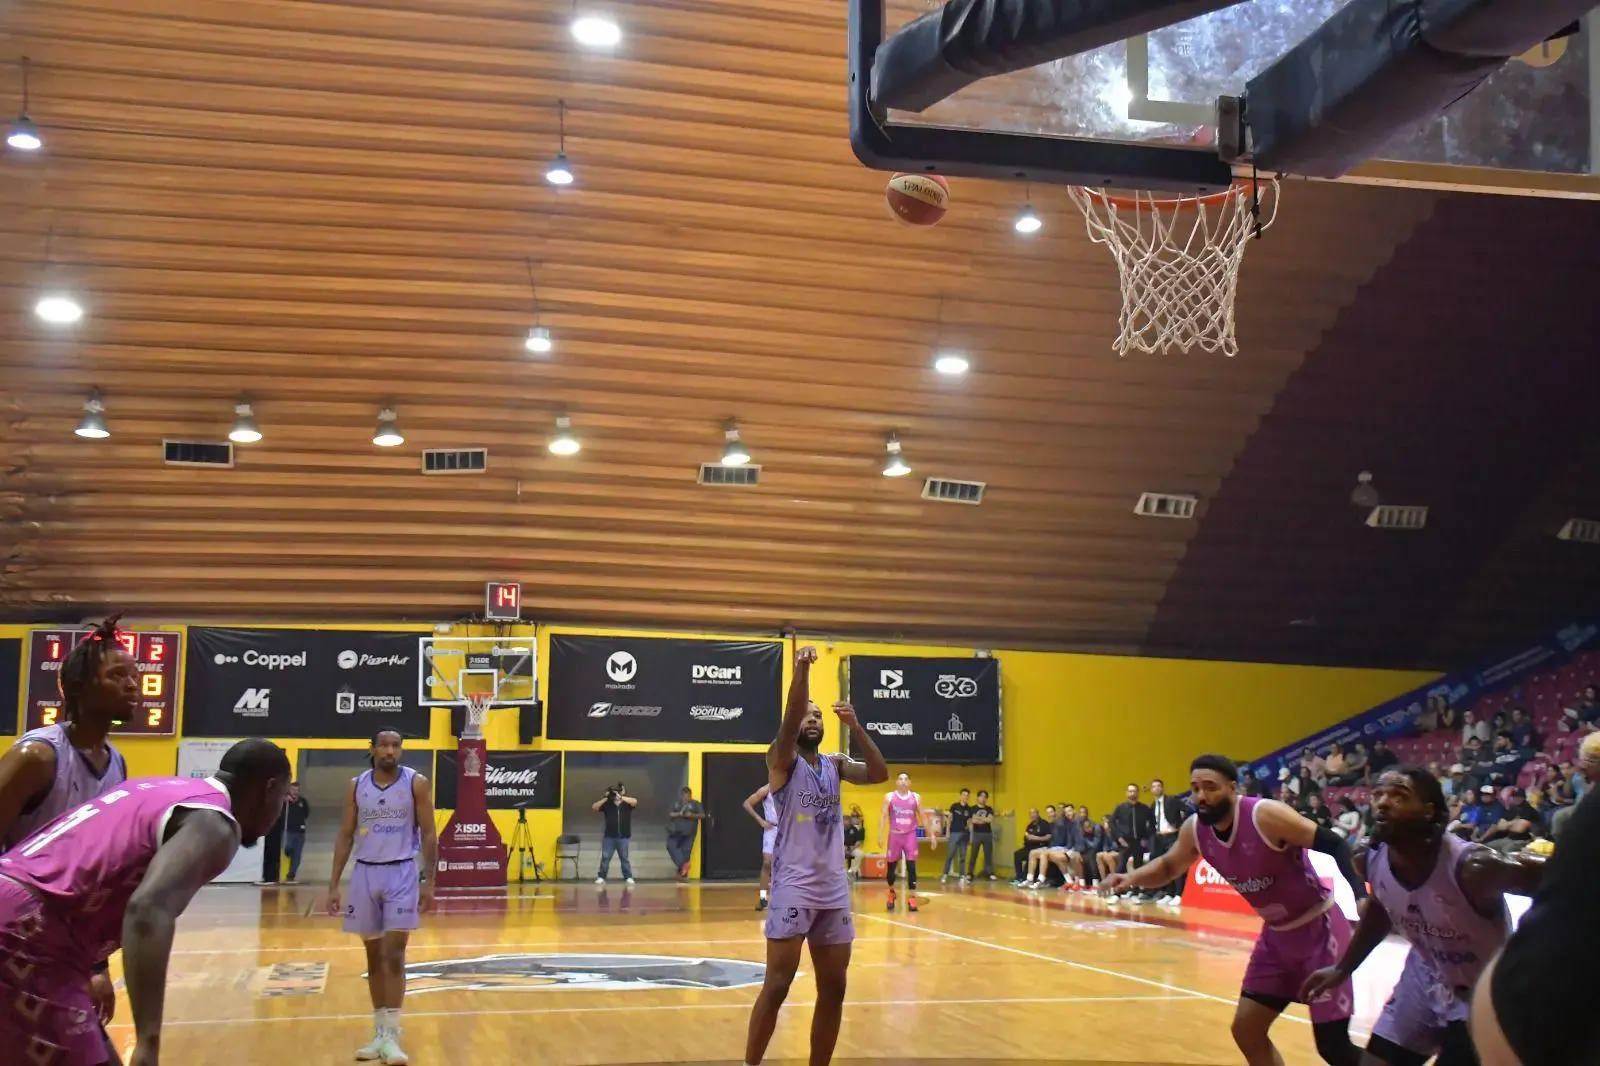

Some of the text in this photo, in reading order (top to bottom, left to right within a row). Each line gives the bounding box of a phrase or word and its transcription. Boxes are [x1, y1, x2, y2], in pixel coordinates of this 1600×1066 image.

[498, 587, 515, 607] 14
[52, 642, 59, 658] 1
[150, 644, 163, 660] 2
[243, 649, 307, 670] Coppel
[359, 653, 410, 666] Pizza Hut
[692, 664, 741, 679] D'Gari
[142, 674, 162, 696] 8
[873, 689, 910, 699] NEW PLAY
[43, 707, 58, 725] 2
[148, 709, 162, 726] 2
[866, 722, 913, 731] EXTREME
[934, 731, 977, 741] CLAMONT
[485, 786, 535, 796] aliente.mx
[463, 823, 487, 833] ISDE
